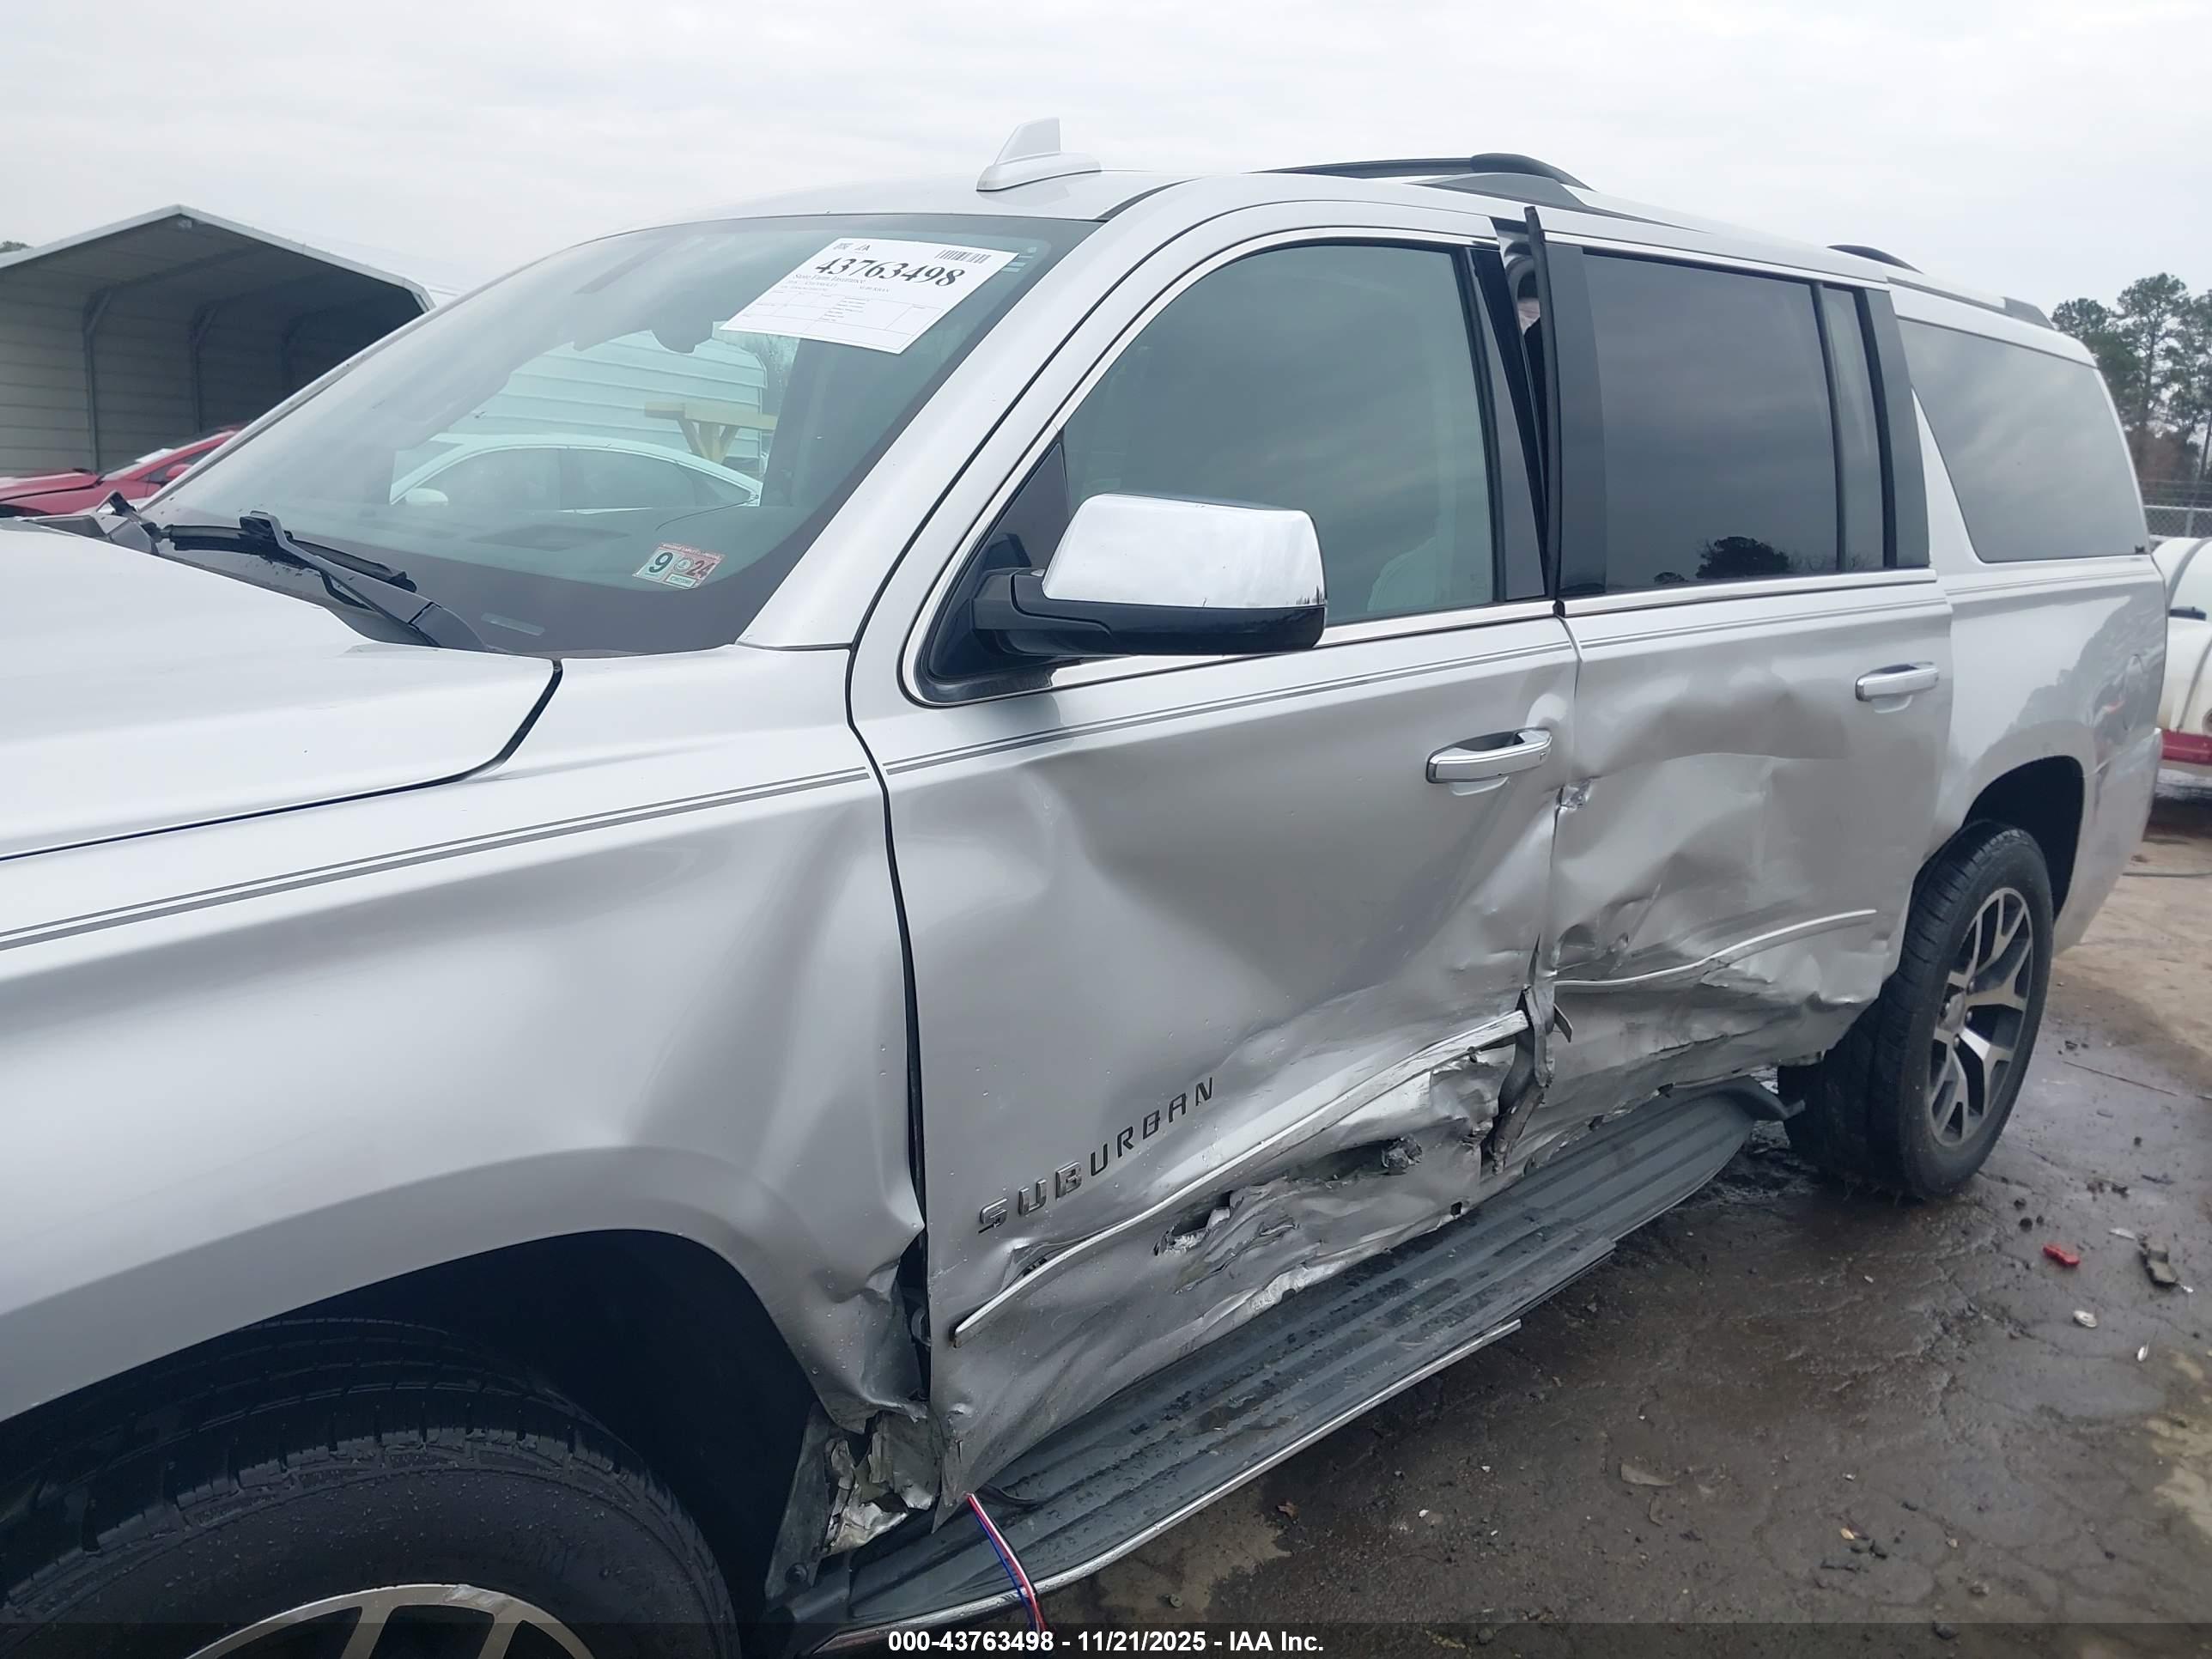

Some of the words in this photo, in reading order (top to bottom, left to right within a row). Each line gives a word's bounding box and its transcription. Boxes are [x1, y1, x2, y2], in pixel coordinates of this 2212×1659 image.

[815, 257, 966, 288] 43763498
[648, 551, 674, 574] 9
[977, 1076, 1213, 1234] SUBURBAN
